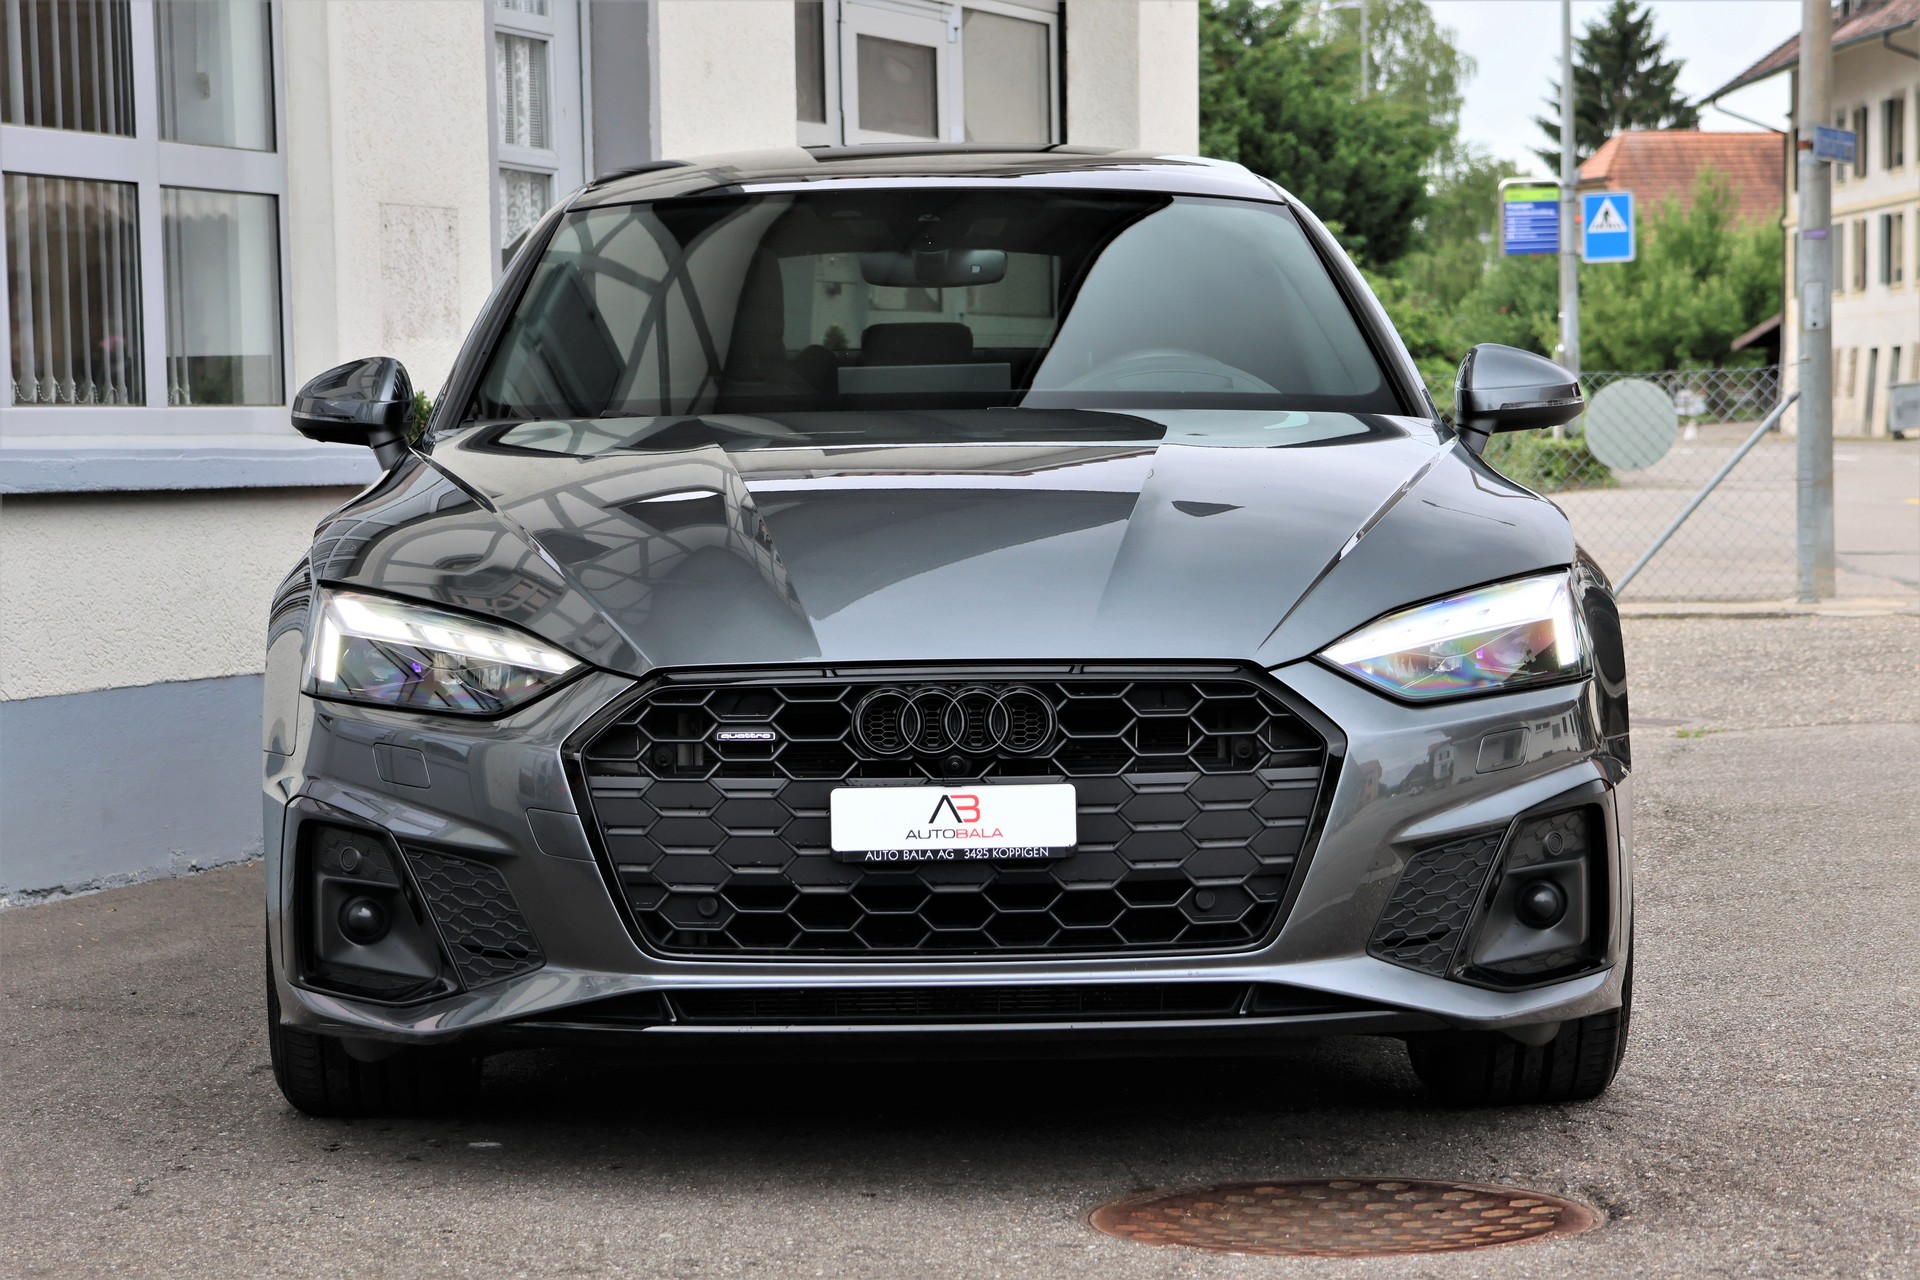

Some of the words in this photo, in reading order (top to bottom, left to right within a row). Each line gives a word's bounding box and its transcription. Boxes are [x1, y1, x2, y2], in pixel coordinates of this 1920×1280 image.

[720, 732, 771, 740] quattro
[905, 828, 1004, 840] AUTOBALA
[865, 850, 899, 861] AUTO
[903, 850, 934, 860] BALA
[937, 849, 955, 860] AG
[964, 848, 990, 859] 3425
[993, 847, 1049, 858] KOPPIGEN
